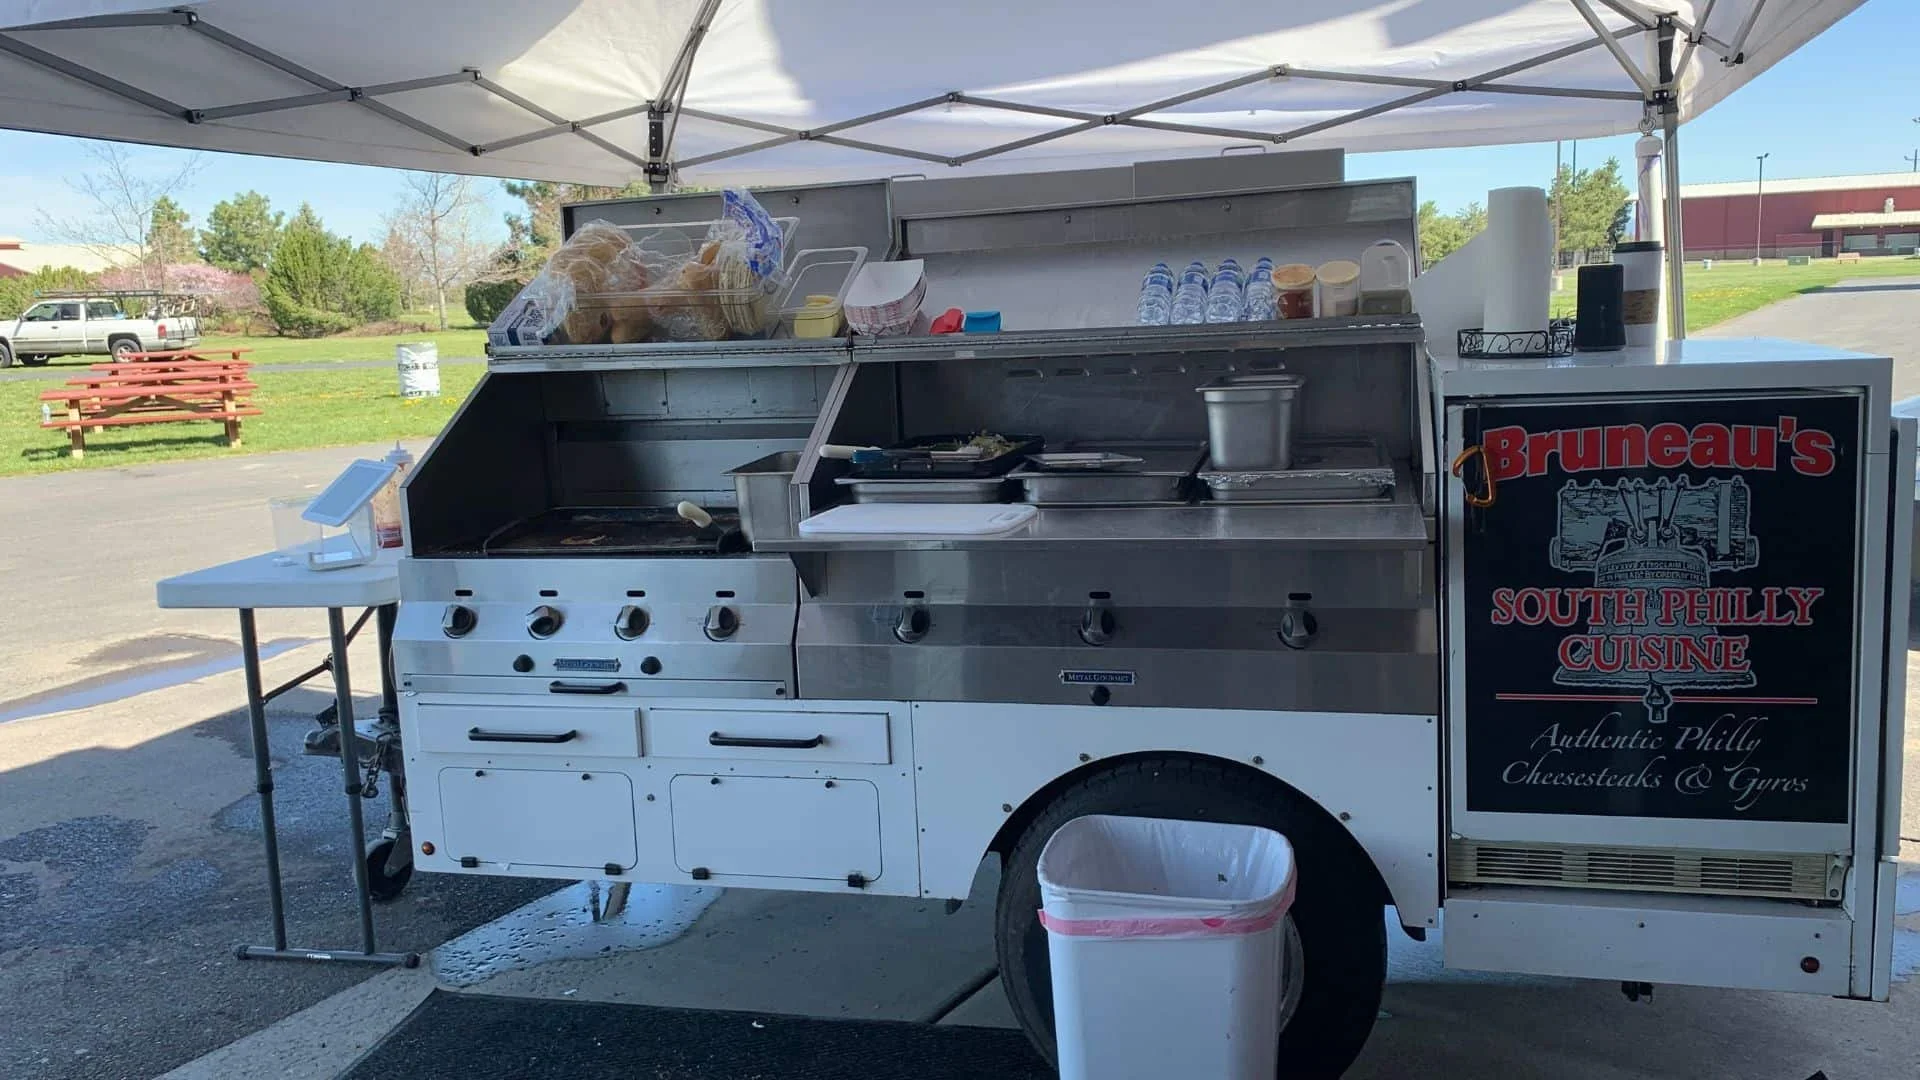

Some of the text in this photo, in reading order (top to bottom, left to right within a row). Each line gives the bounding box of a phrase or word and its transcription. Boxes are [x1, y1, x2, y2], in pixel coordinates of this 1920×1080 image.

[1483, 415, 1836, 482] Bruneau's
[1491, 587, 1824, 625] SOUTH PHILLY
[1558, 634, 1751, 672] CUISINE
[1530, 711, 1768, 771] Authentic Philly
[1501, 749, 1808, 811] Cheesesteaks & Gyros
